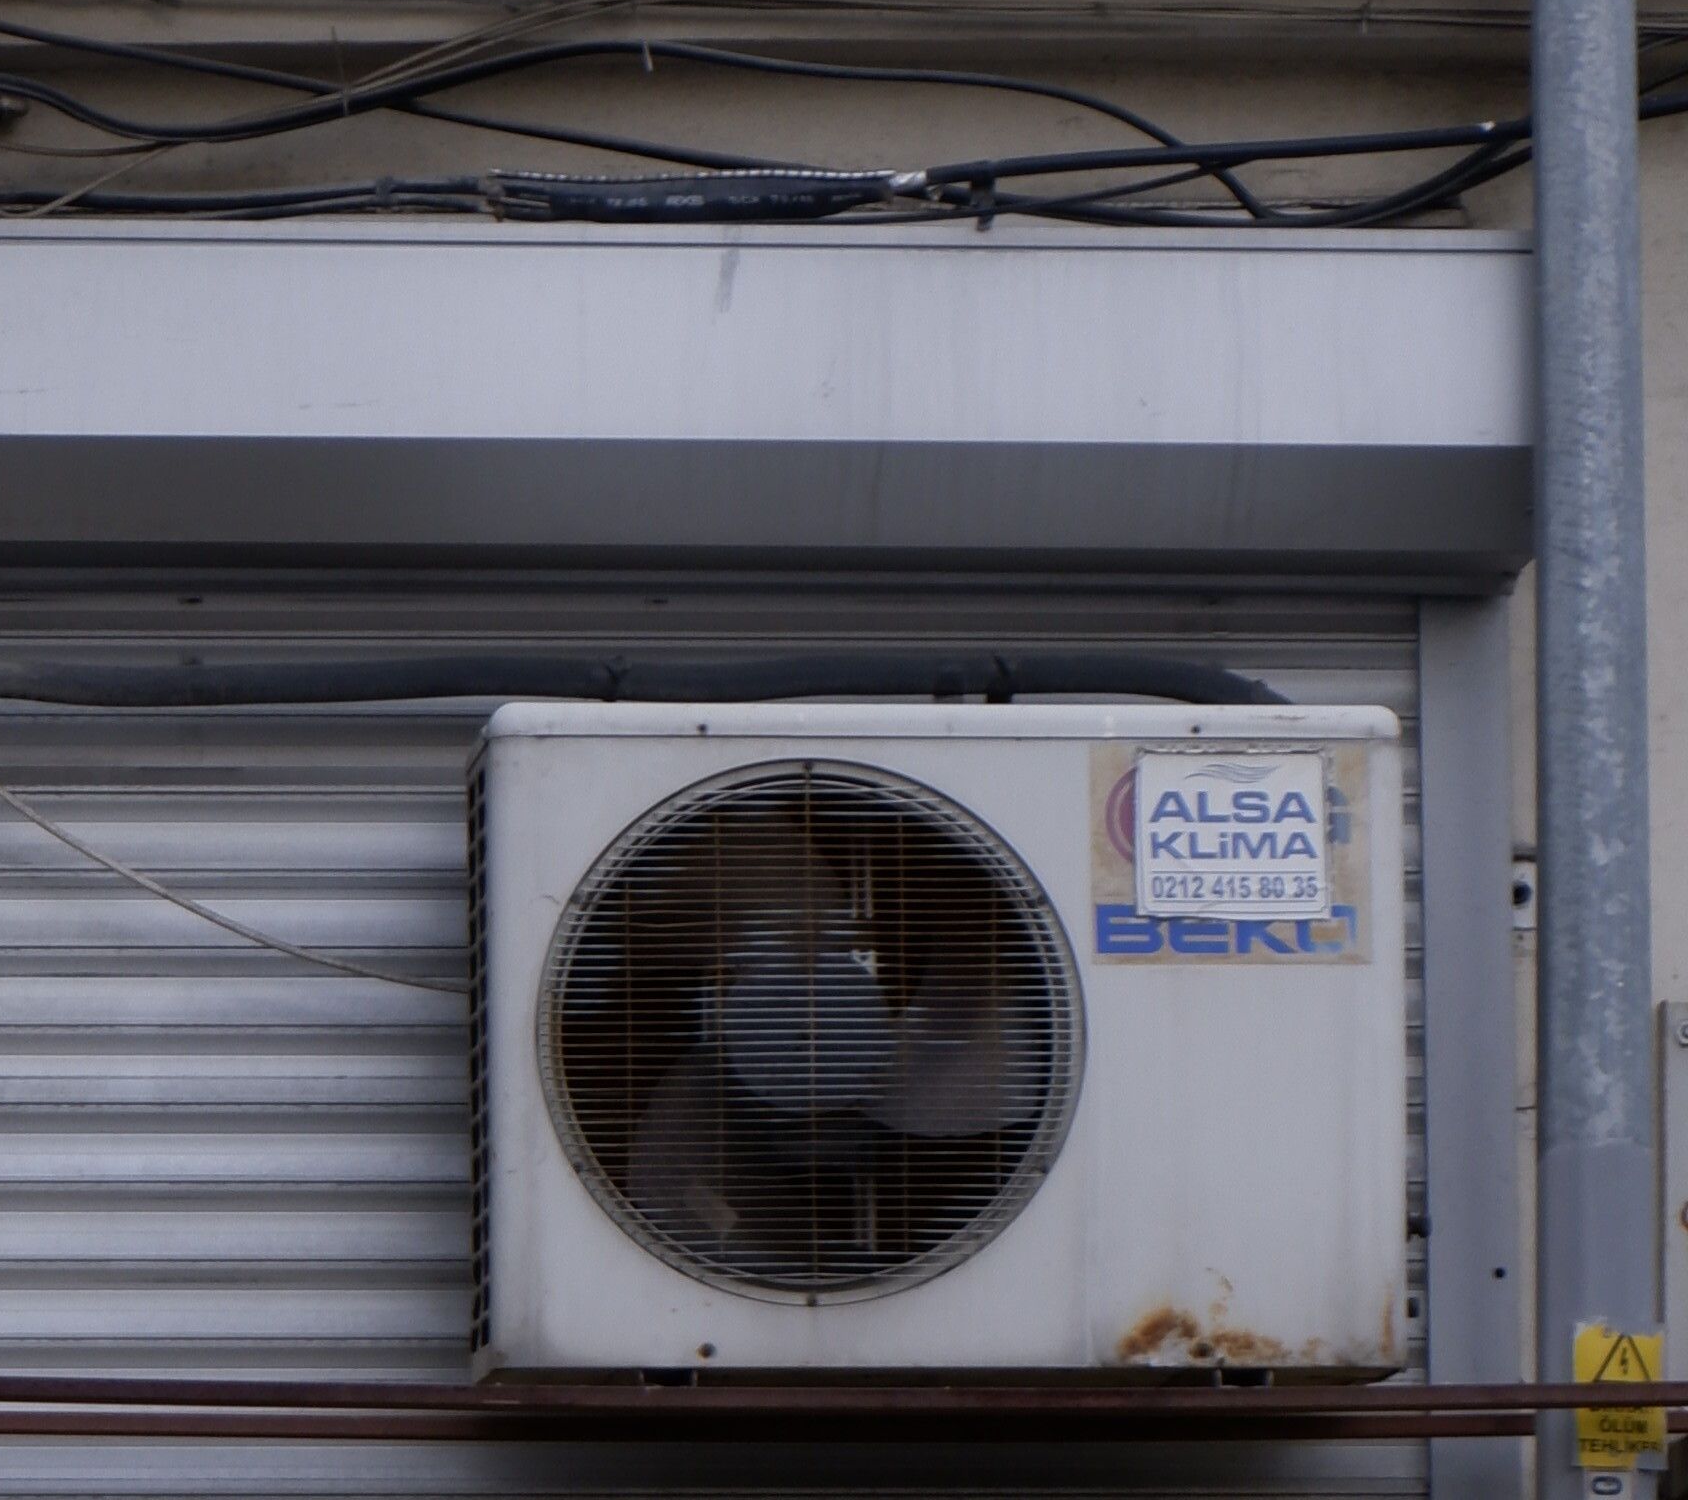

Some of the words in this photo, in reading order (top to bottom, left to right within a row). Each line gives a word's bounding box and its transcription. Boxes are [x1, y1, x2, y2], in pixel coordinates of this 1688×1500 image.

[1149, 790, 1317, 824] ALSA
[1151, 876, 1205, 899] 0212
[1212, 876, 1252, 899] 415
